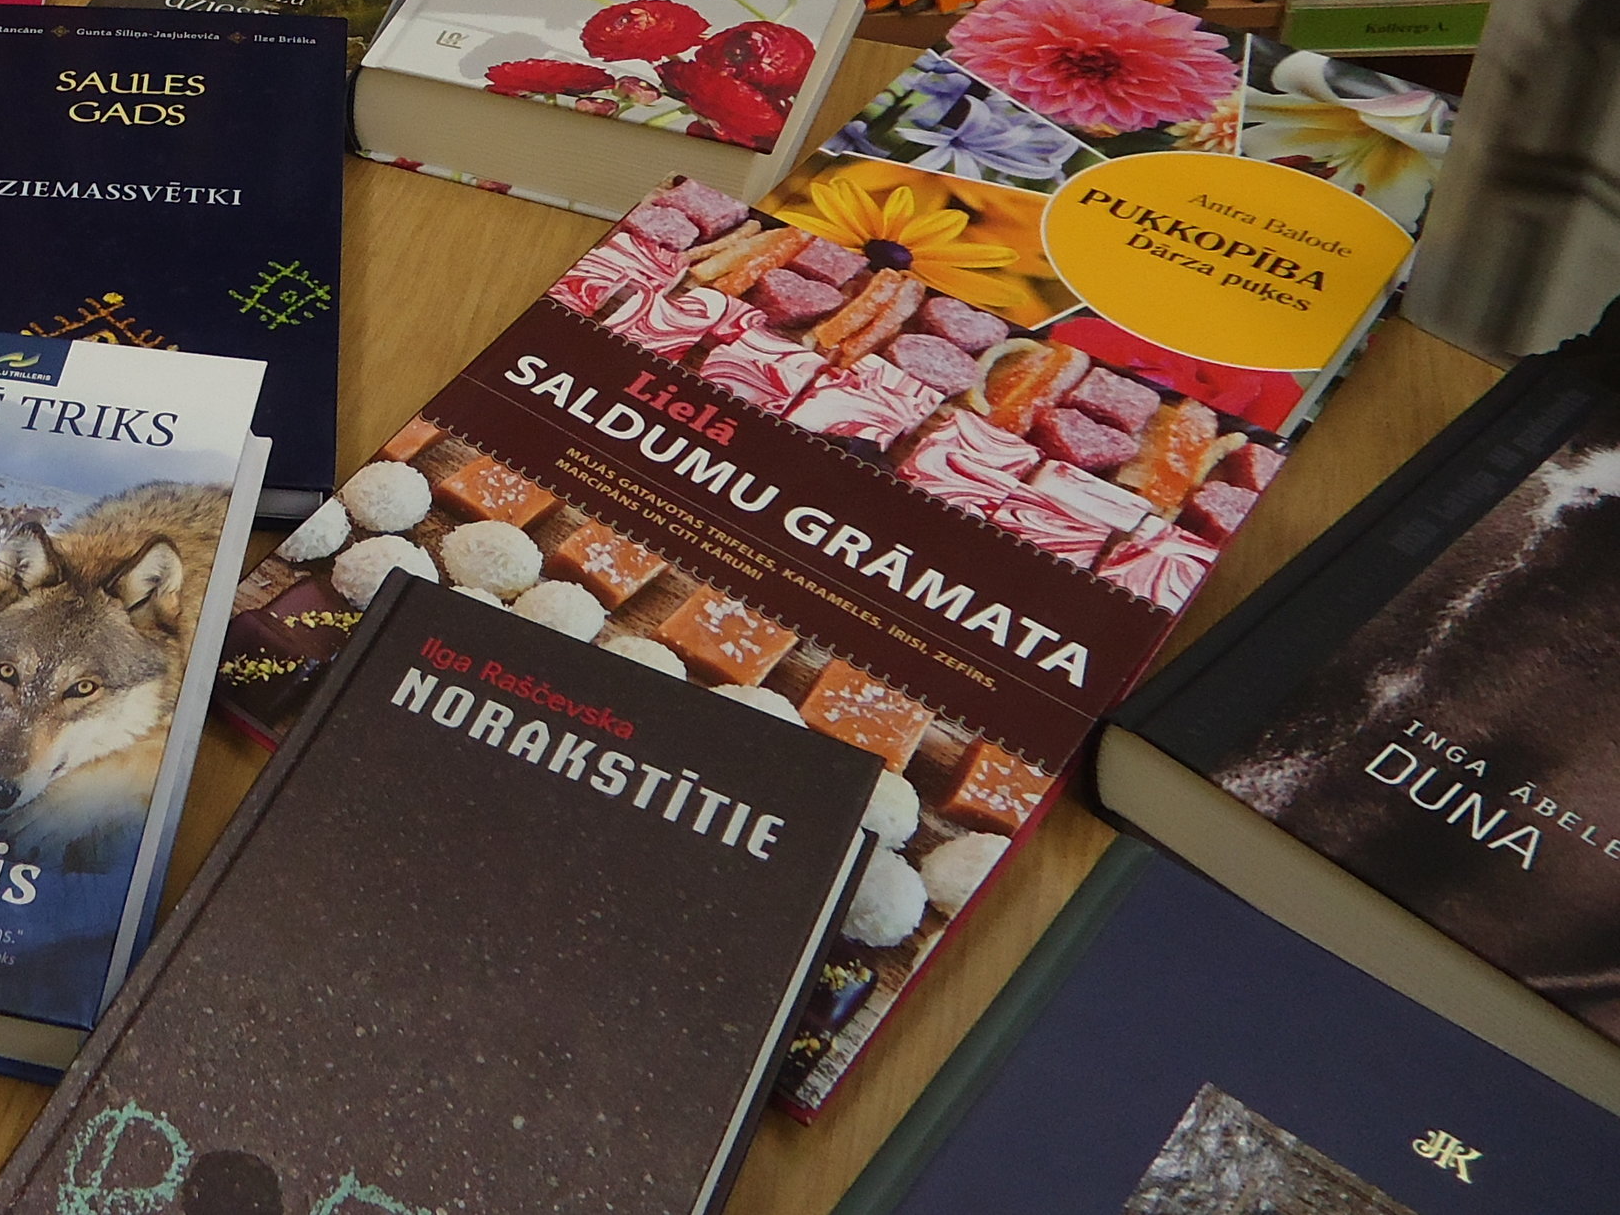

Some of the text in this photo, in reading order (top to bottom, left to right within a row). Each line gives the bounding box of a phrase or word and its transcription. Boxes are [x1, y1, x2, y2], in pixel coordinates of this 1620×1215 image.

[76, 28, 113, 37] Gunta
[253, 35, 276, 43] Ilze
[278, 35, 317, 45] Briška
[55, 70, 207, 97] SAULES
[68, 101, 187, 126] GADS
[1078, 187, 1326, 291] PUĶKOPĪBA
[1188, 193, 1353, 259] Antra Balode
[1125, 233, 1312, 313] Dārza puķes
[9, 370, 52, 382] TRILLERIS
[623, 370, 738, 447] Lielā
[20, 396, 179, 447] TRIKS
[504, 355, 1089, 688] SALDUMU GRĀMATA
[554, 457, 764, 581] MARCIPĀNS UN CITI KĀRUMI
[618, 477, 704, 530] GATAVOTAS
[706, 525, 778, 573] TRIFELES,
[781, 568, 884, 629] KARAMELES,
[887, 624, 929, 655] ĪRISI,
[932, 650, 997, 692] ZEFĪRS,
[420, 636, 636, 740] Ilga Raščevska
[390, 667, 786, 860] NORAKSTĪTIE
[1402, 719, 1487, 777] INGA
[1364, 742, 1542, 871] DUNA
